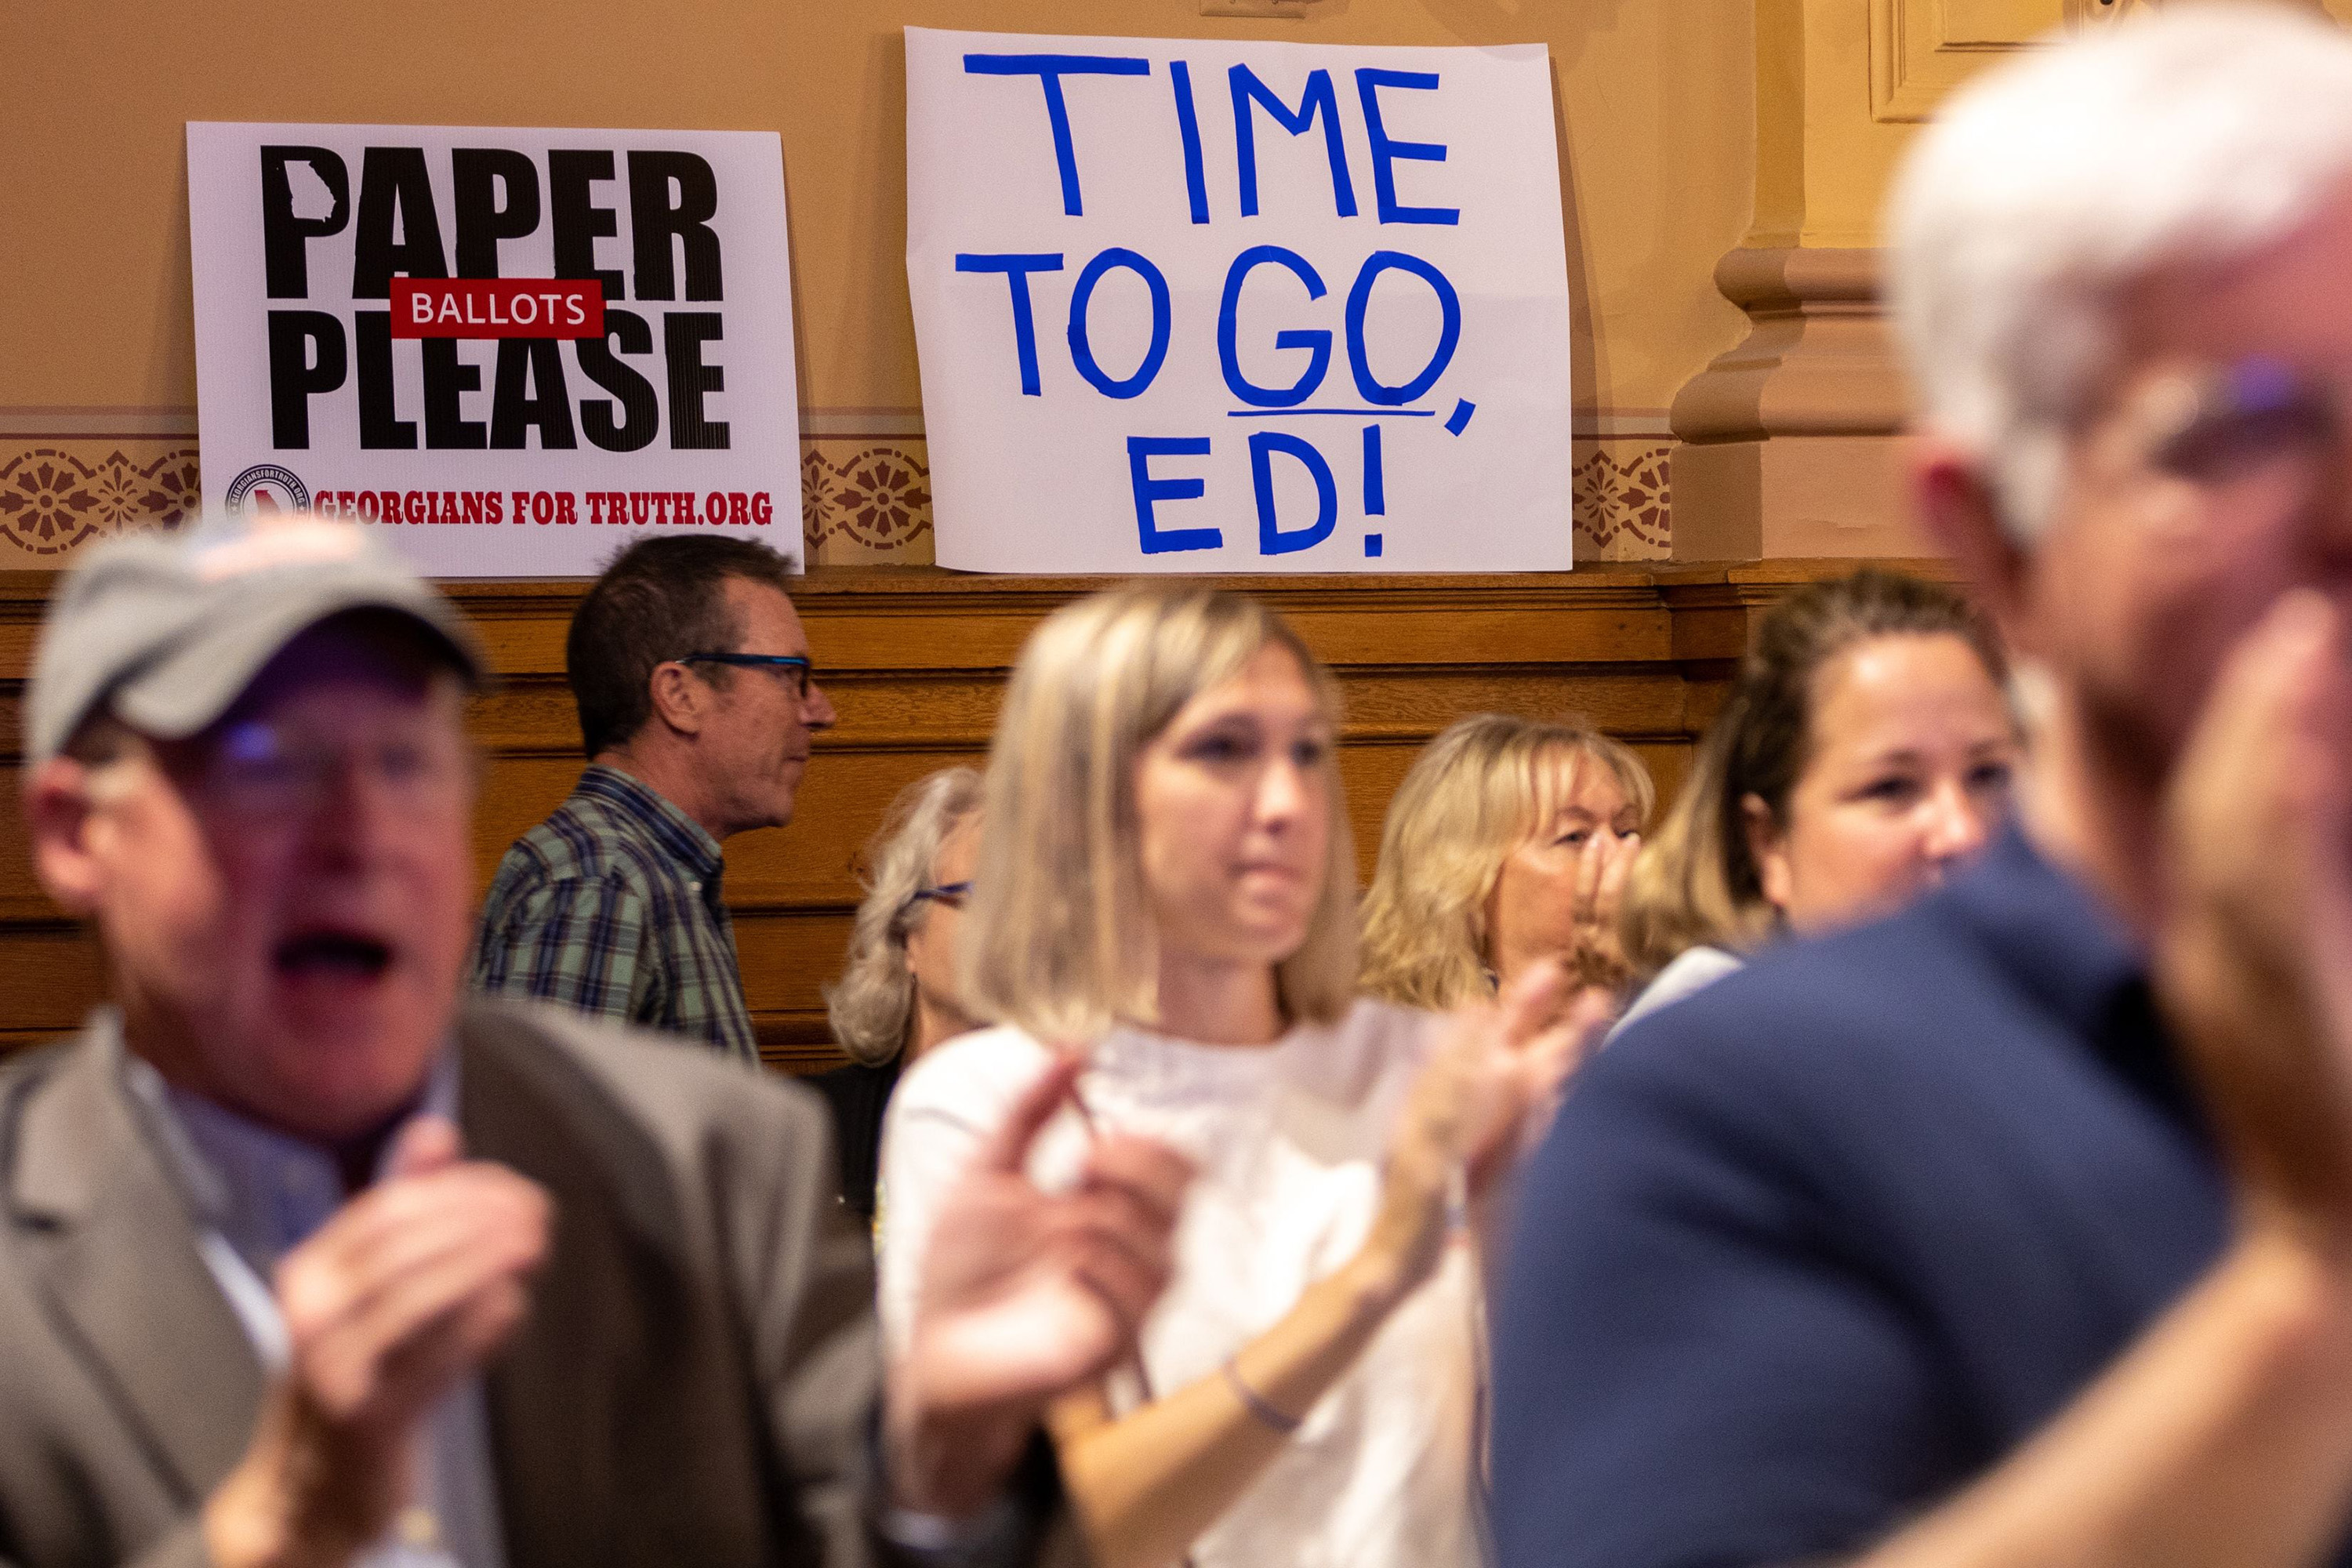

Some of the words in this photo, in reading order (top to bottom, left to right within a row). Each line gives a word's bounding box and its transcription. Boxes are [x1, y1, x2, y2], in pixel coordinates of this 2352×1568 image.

[963, 54, 1460, 225] TIME
[260, 145, 724, 302] PAPER
[412, 292, 586, 325] BALLOTS
[955, 247, 1171, 399] TO
[1218, 245, 1476, 436] GO,
[267, 308, 731, 452] PLEASE
[230, 469, 306, 503] GEORGIANSFORTRUTH.ORG
[314, 490, 503, 524] GEORGIANS
[512, 491, 578, 524] FOR
[586, 491, 773, 525] TRUTH.ORG
[1127, 424, 1385, 557] ED!
